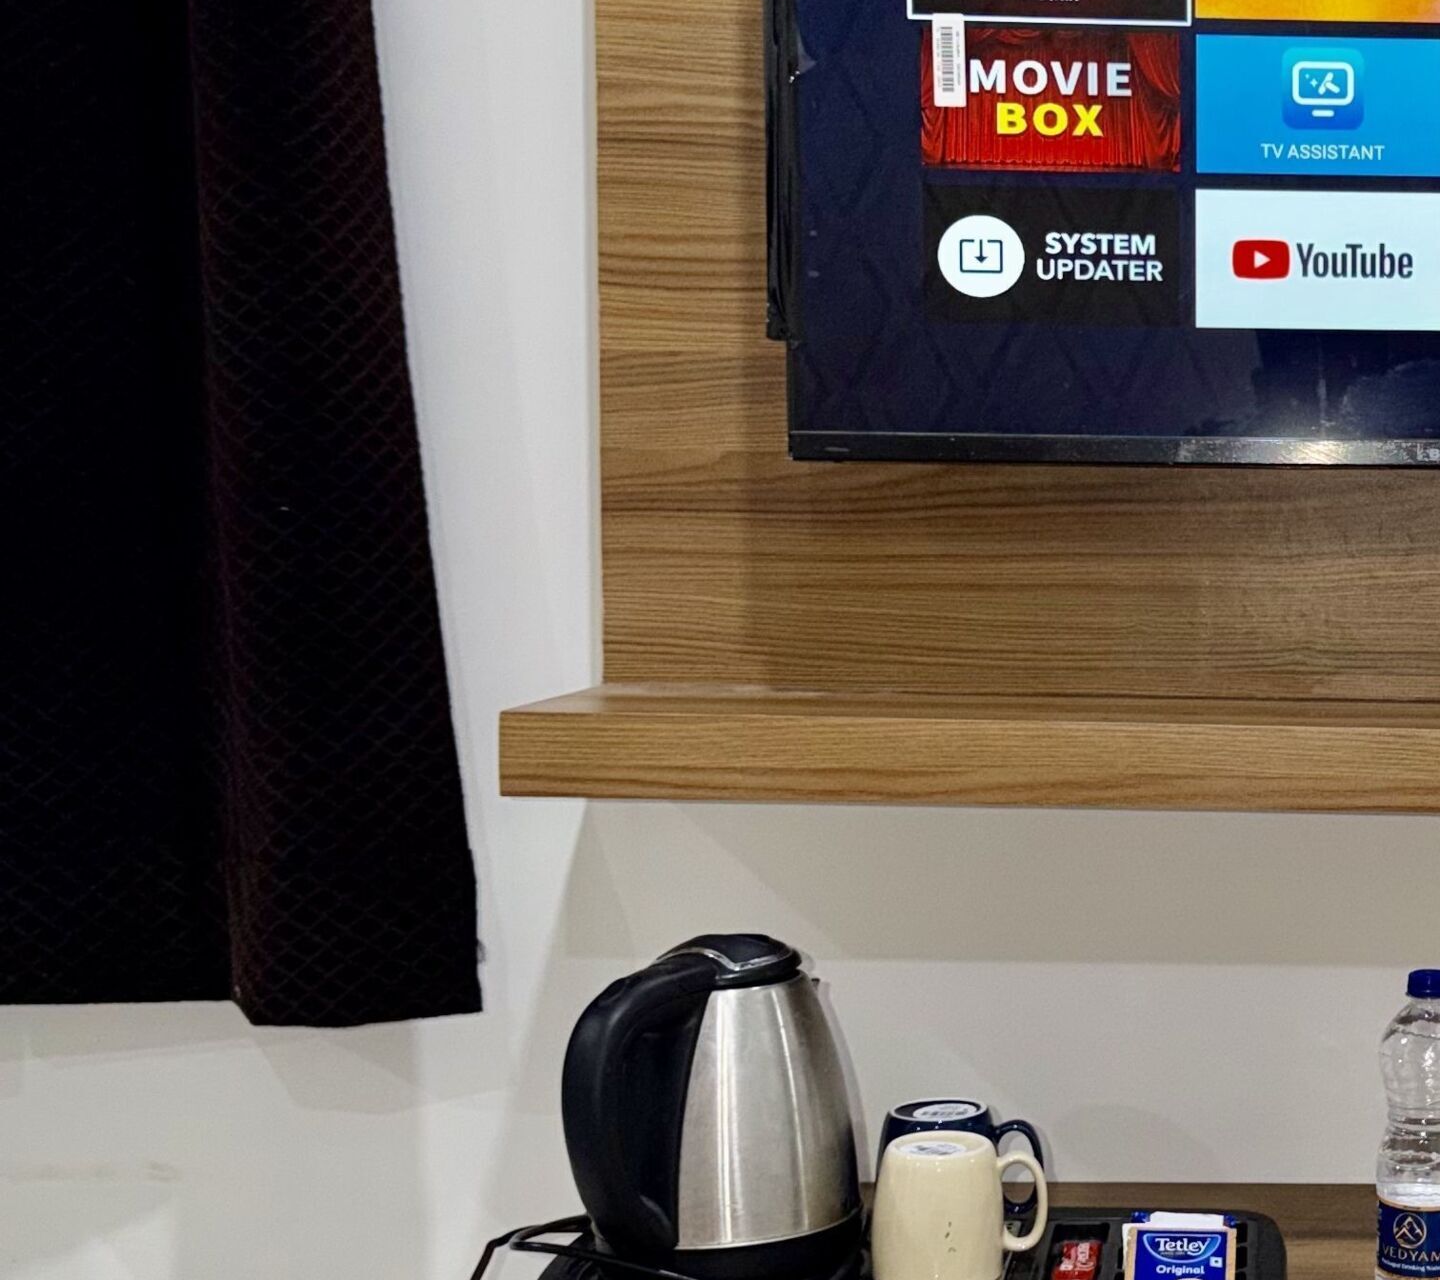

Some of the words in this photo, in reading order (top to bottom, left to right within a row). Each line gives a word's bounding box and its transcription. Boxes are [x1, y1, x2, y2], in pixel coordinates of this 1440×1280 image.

[969, 59, 1133, 98] MOVIE
[996, 102, 1105, 138] BOX
[1260, 143, 1284, 160] TV
[1287, 144, 1385, 162] ASSISTANT
[1045, 232, 1156, 256] SYSTEM
[1036, 258, 1164, 283] UPDATER
[1296, 242, 1414, 280] YouTube
[1155, 1237, 1212, 1256] Tetley
[1155, 1264, 1206, 1276] Original
